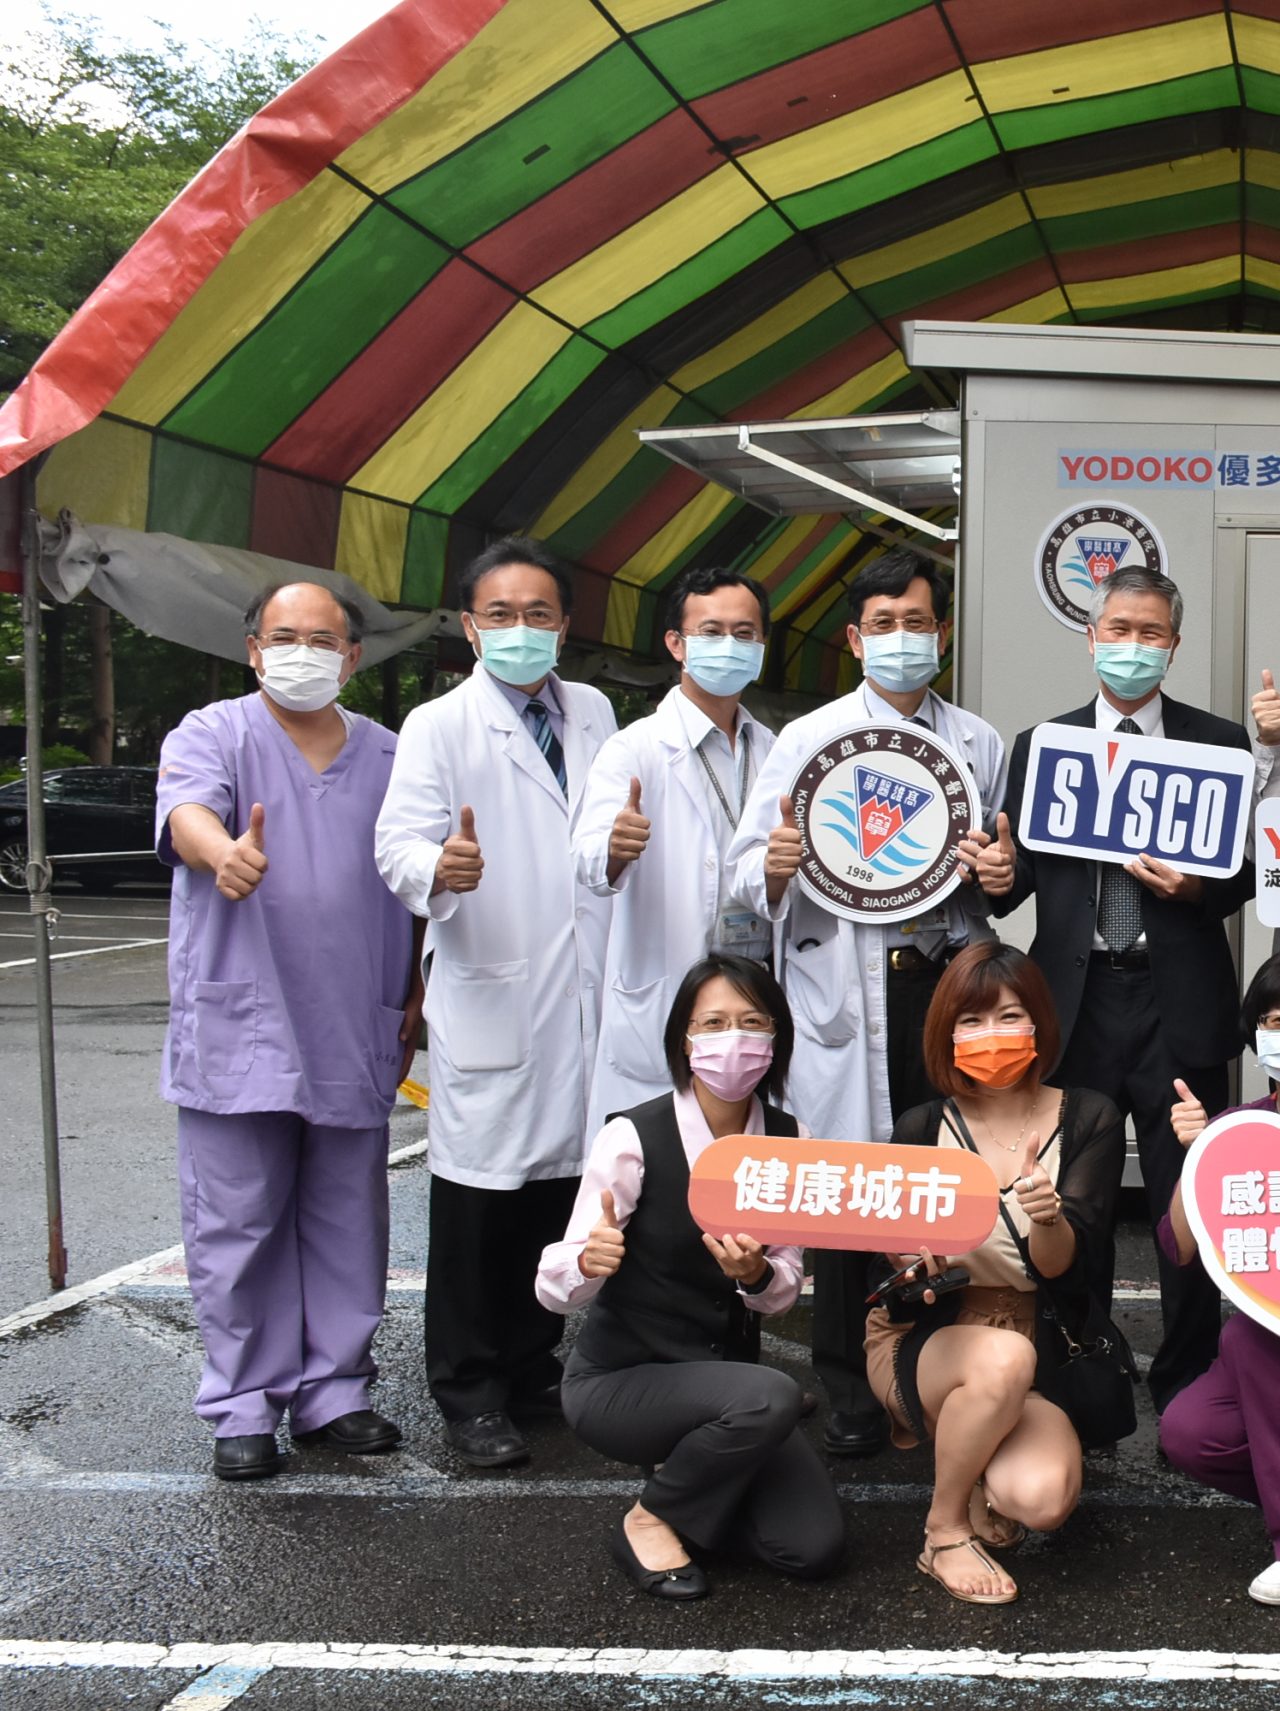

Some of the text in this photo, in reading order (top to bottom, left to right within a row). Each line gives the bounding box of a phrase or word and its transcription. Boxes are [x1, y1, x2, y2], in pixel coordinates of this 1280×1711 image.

[1060, 456, 1213, 482] YODOKO
[1045, 562, 1089, 622] KAOHSIUNG MUNIC
[816, 731, 968, 820] 高雄市立小港醫院
[1047, 742, 1228, 859] SYSCO
[805, 859, 855, 904] MUNICIPAL
[861, 887, 921, 908] SIAOGANG
[845, 865, 874, 882] 1998
[733, 1156, 962, 1223] 健康城市
